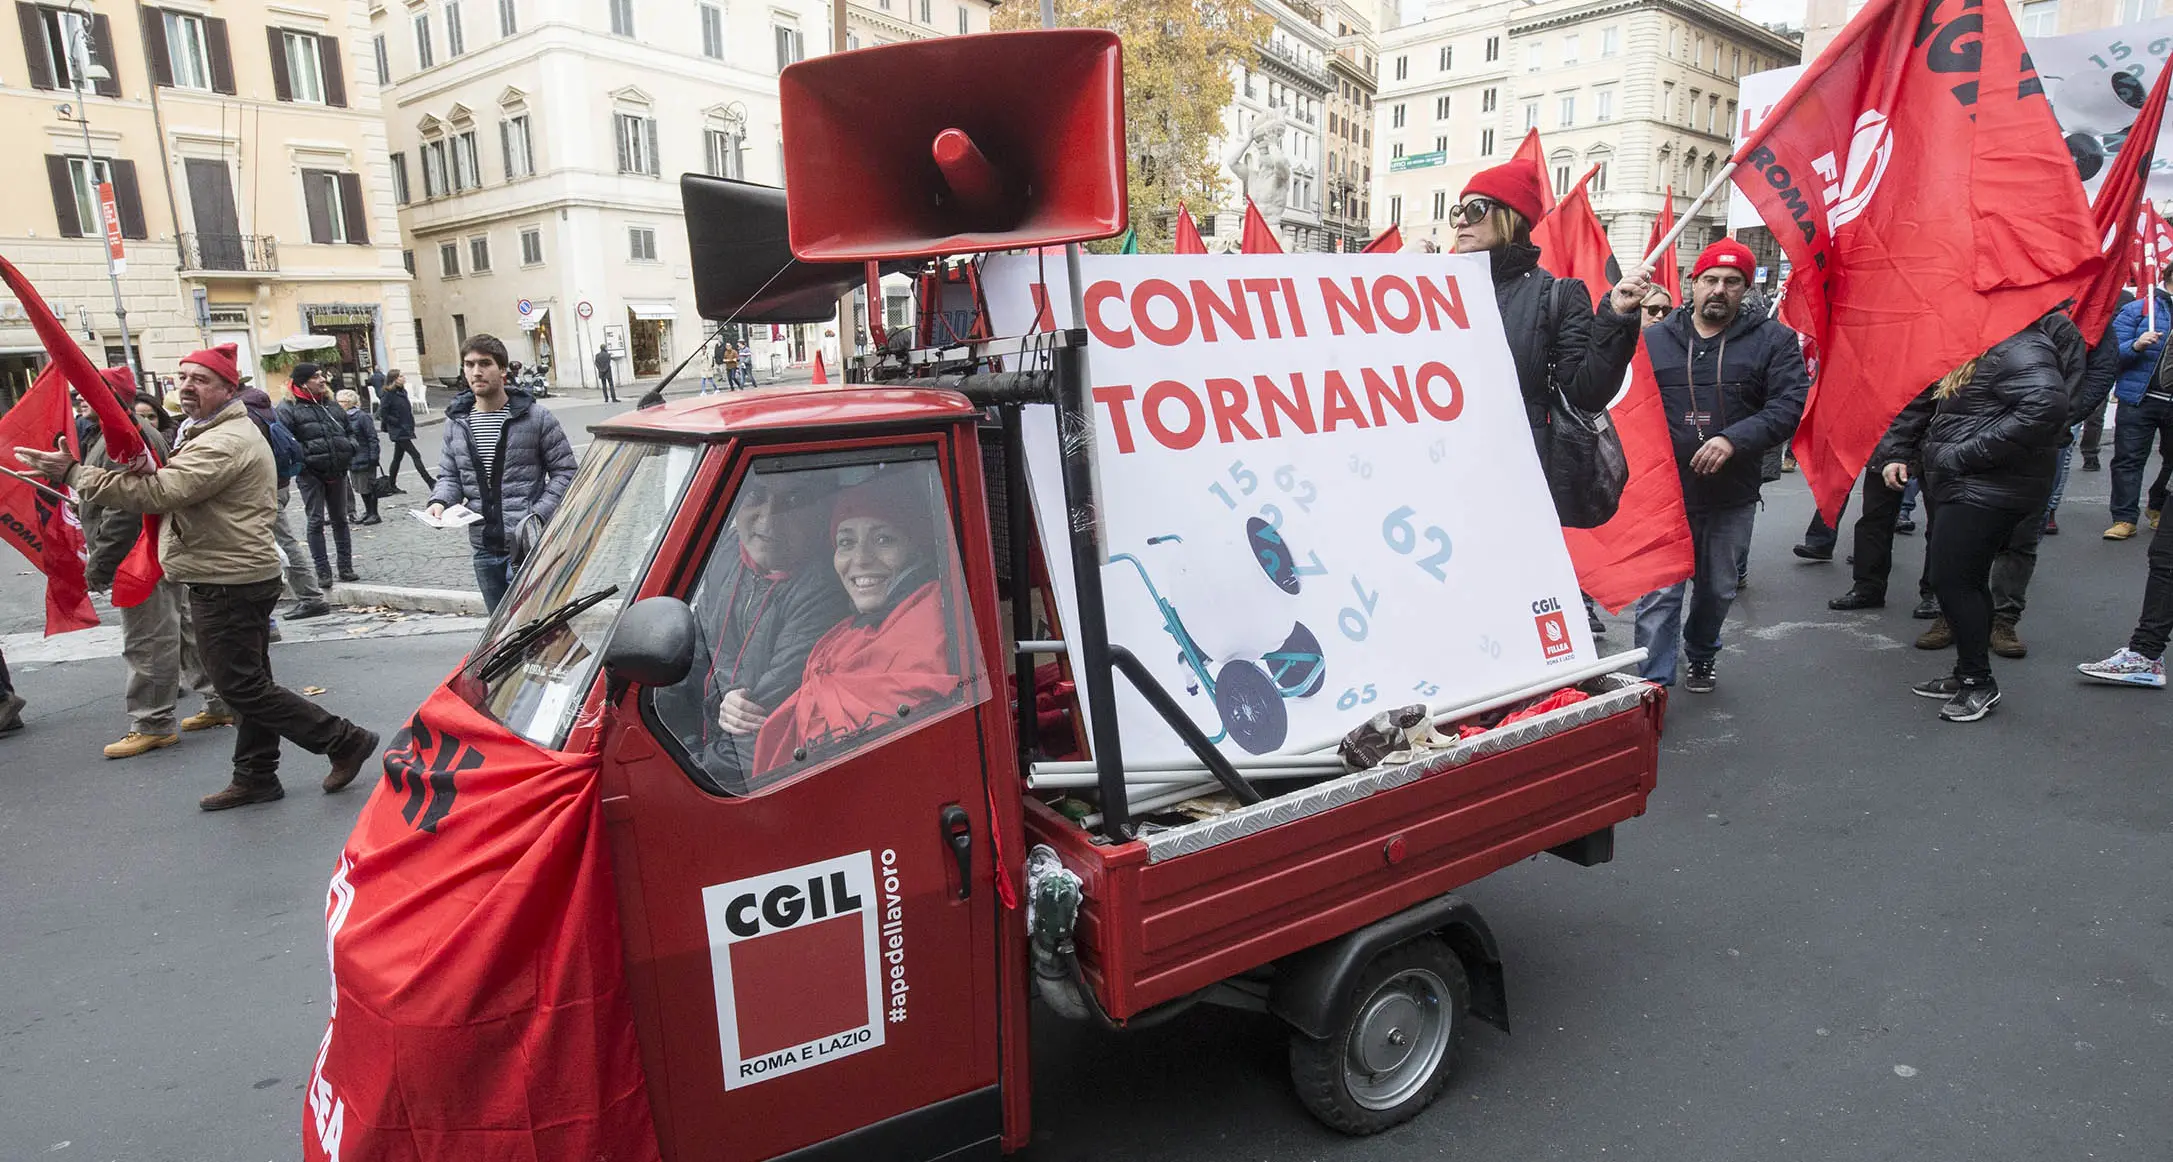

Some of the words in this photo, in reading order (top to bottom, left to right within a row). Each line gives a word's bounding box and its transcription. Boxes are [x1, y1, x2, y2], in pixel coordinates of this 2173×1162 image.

[2088, 40, 2132, 69] 15
[1748, 146, 1816, 246] ROMA
[1084, 278, 1307, 349] CONTI
[1318, 274, 1471, 336] NON
[1091, 361, 1464, 454] TORNANO
[1207, 460, 1258, 511] 15
[1273, 464, 1318, 513] 62
[0, 512, 43, 553] ROMA
[1382, 505, 1453, 583] 62
[1338, 573, 1380, 642] 70
[1532, 597, 1560, 614] CGIL
[1547, 643, 1569, 655] FILLEA
[1336, 683, 1378, 711] 65
[1412, 680, 1440, 696] 15
[725, 870, 862, 937] CGIL
[880, 848, 909, 1023] #apedellavoro
[739, 1052, 797, 1078] ROMA
[801, 1046, 813, 1060] E
[819, 1029, 872, 1056] LAZIO
